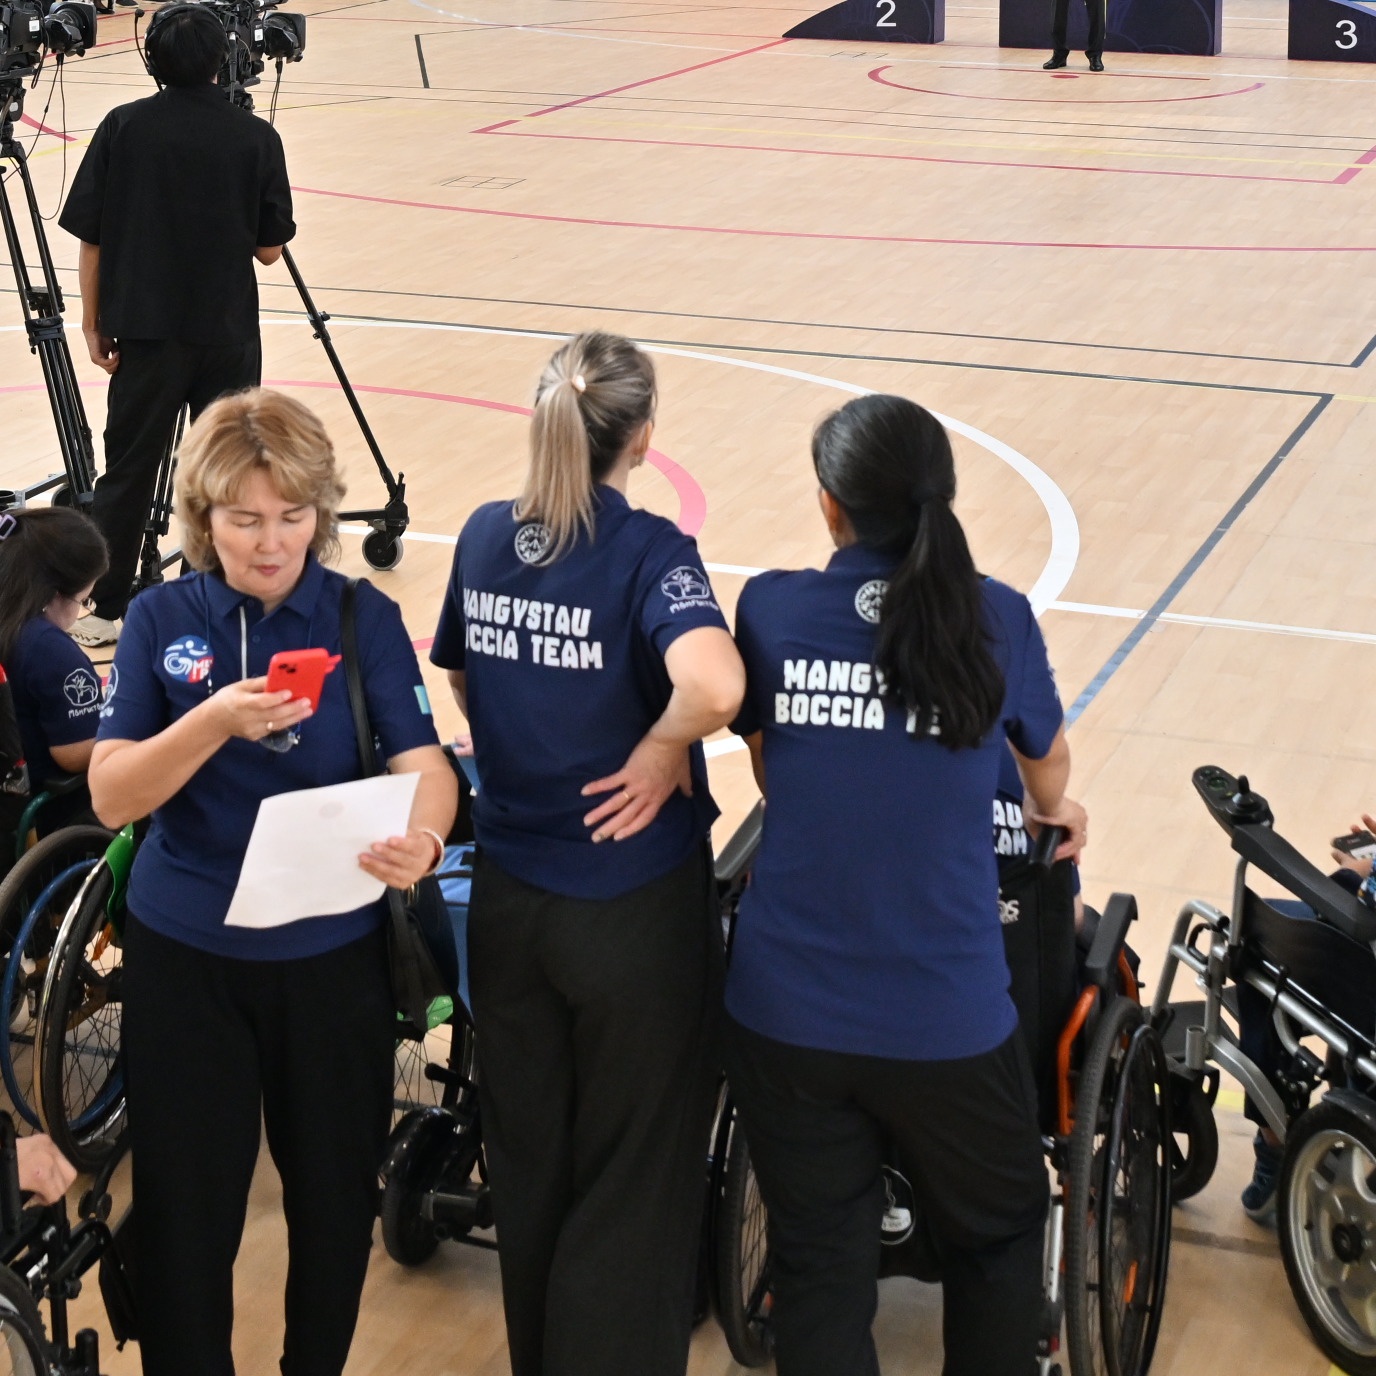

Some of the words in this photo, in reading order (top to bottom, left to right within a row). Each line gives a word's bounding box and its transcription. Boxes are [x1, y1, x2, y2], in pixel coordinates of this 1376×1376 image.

[1334, 19, 1358, 50] 3
[465, 623, 519, 661] CCIA
[530, 634, 604, 670] TEAM
[774, 692, 885, 731] BOCCIA
